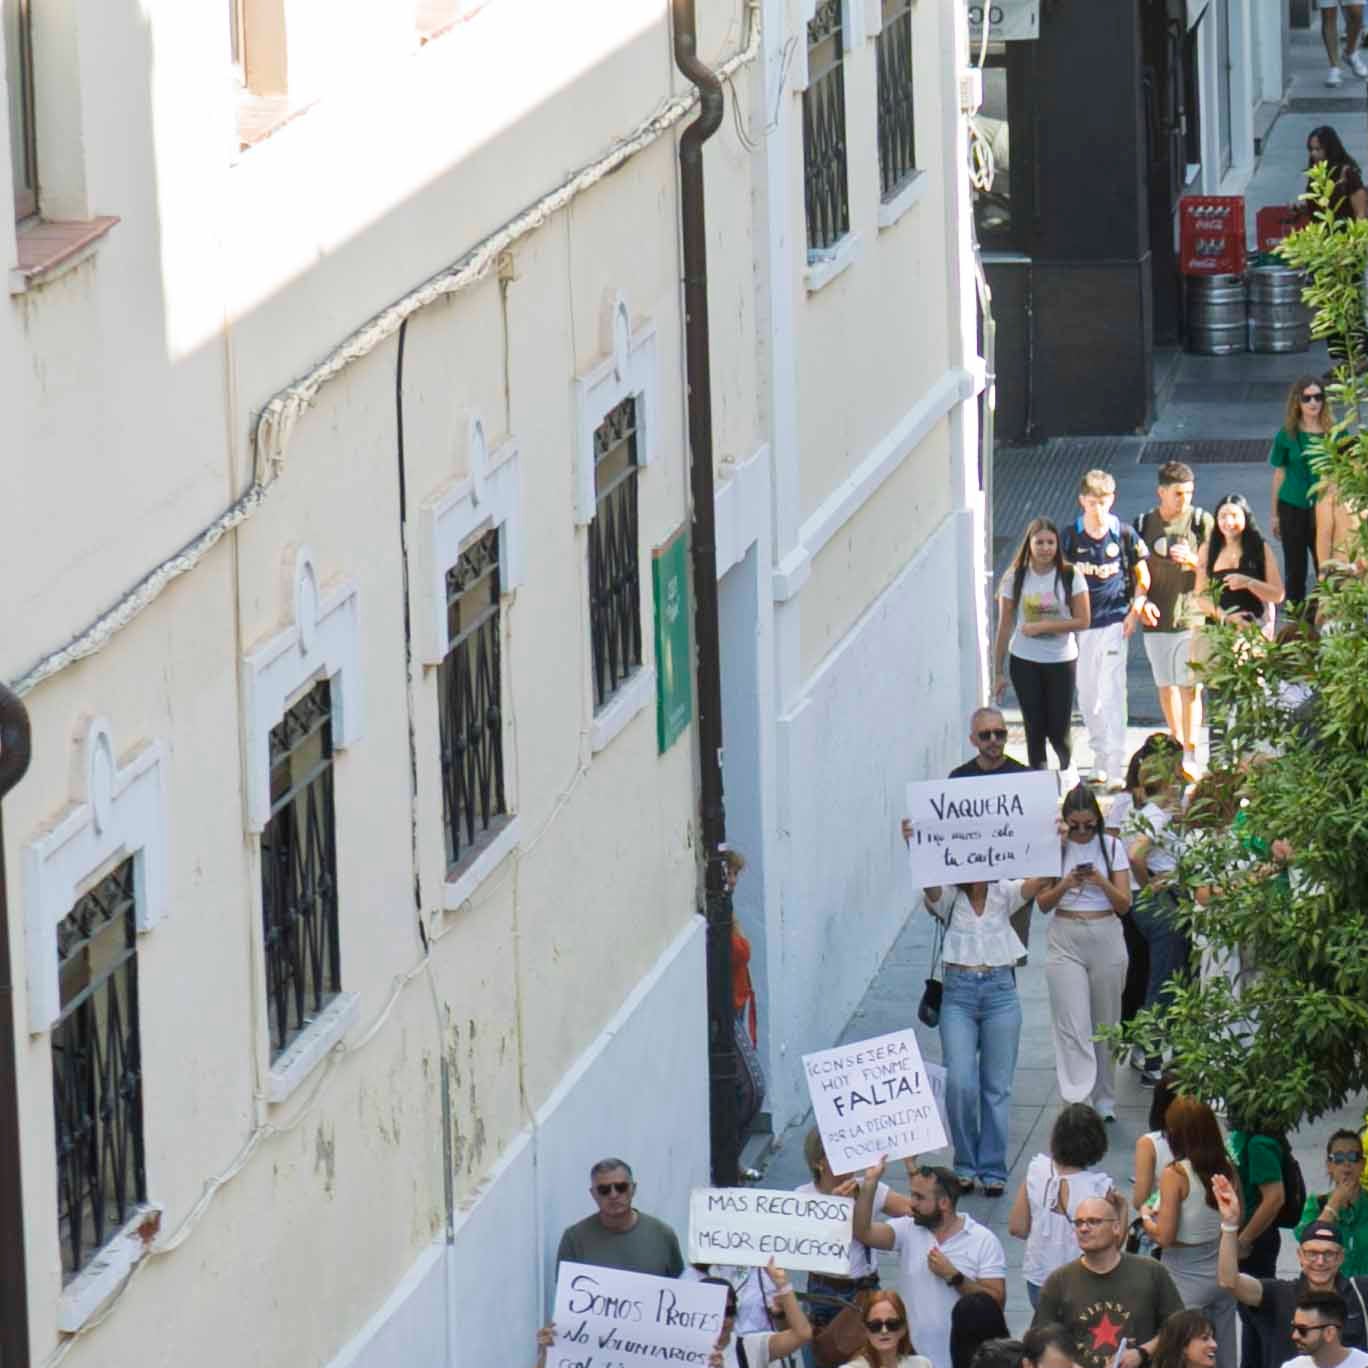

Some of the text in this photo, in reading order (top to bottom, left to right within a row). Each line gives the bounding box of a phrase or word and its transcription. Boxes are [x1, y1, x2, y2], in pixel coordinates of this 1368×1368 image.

[930, 792, 1025, 821] VAQUERA
[832, 1071, 922, 1118] FALTA!
[755, 1194, 850, 1222] RECURSOS
[698, 1230, 755, 1251] MEJOR
[1079, 1301, 1131, 1322] VIENNA
